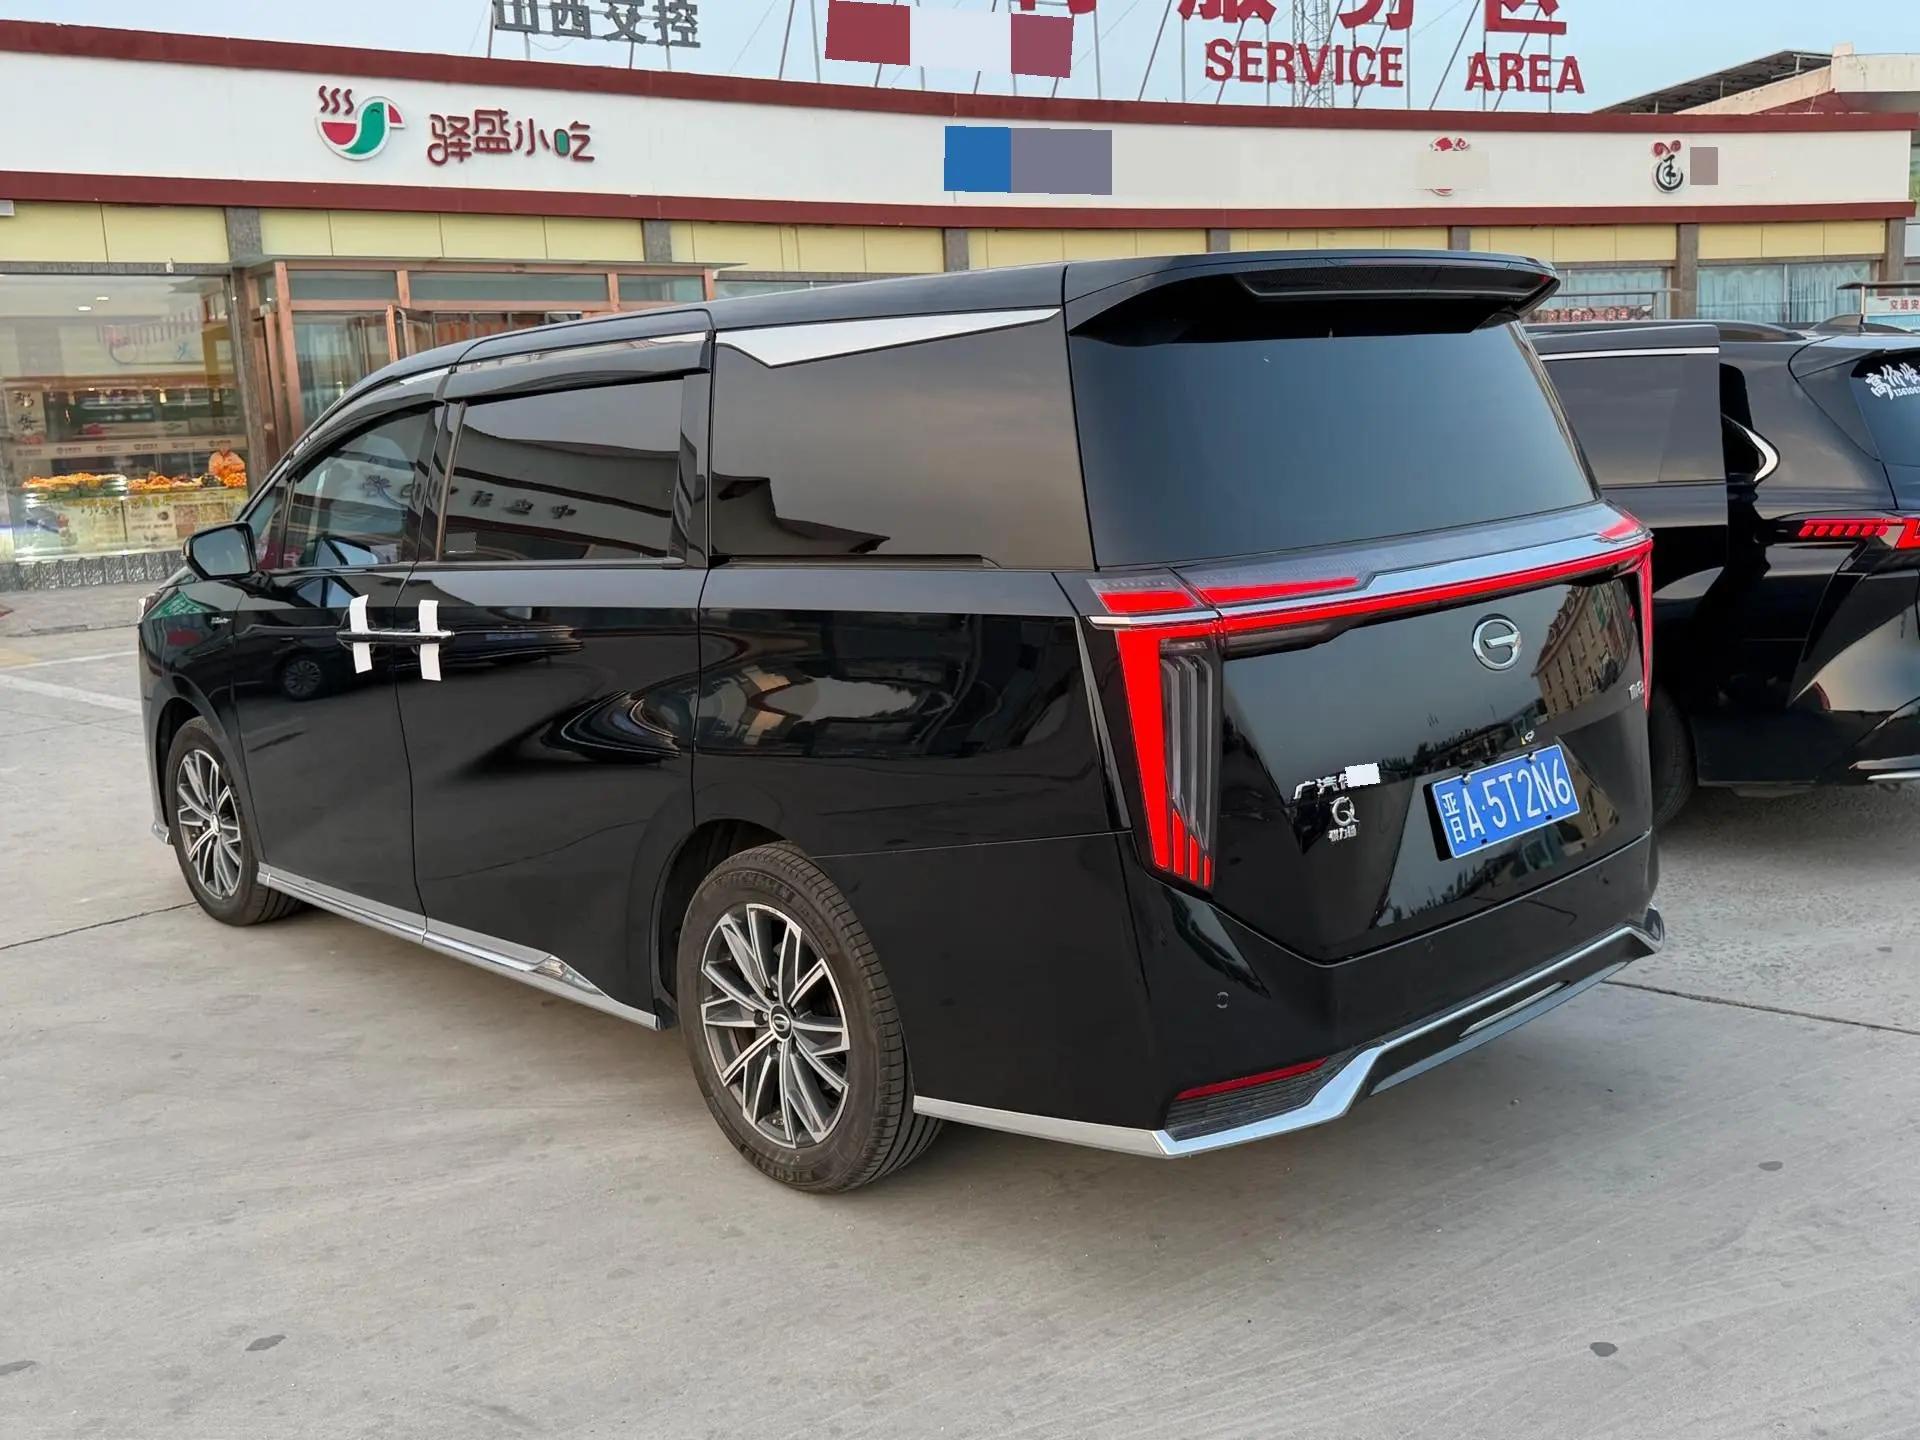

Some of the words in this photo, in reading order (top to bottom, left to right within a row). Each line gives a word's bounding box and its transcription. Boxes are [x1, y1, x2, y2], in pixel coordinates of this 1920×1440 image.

[493, 0, 701, 48] 山西交控
[1204, 37, 1404, 88] SERVICE
[1464, 52, 1586, 94] AREA
[427, 108, 595, 166] 驿盛小吃
